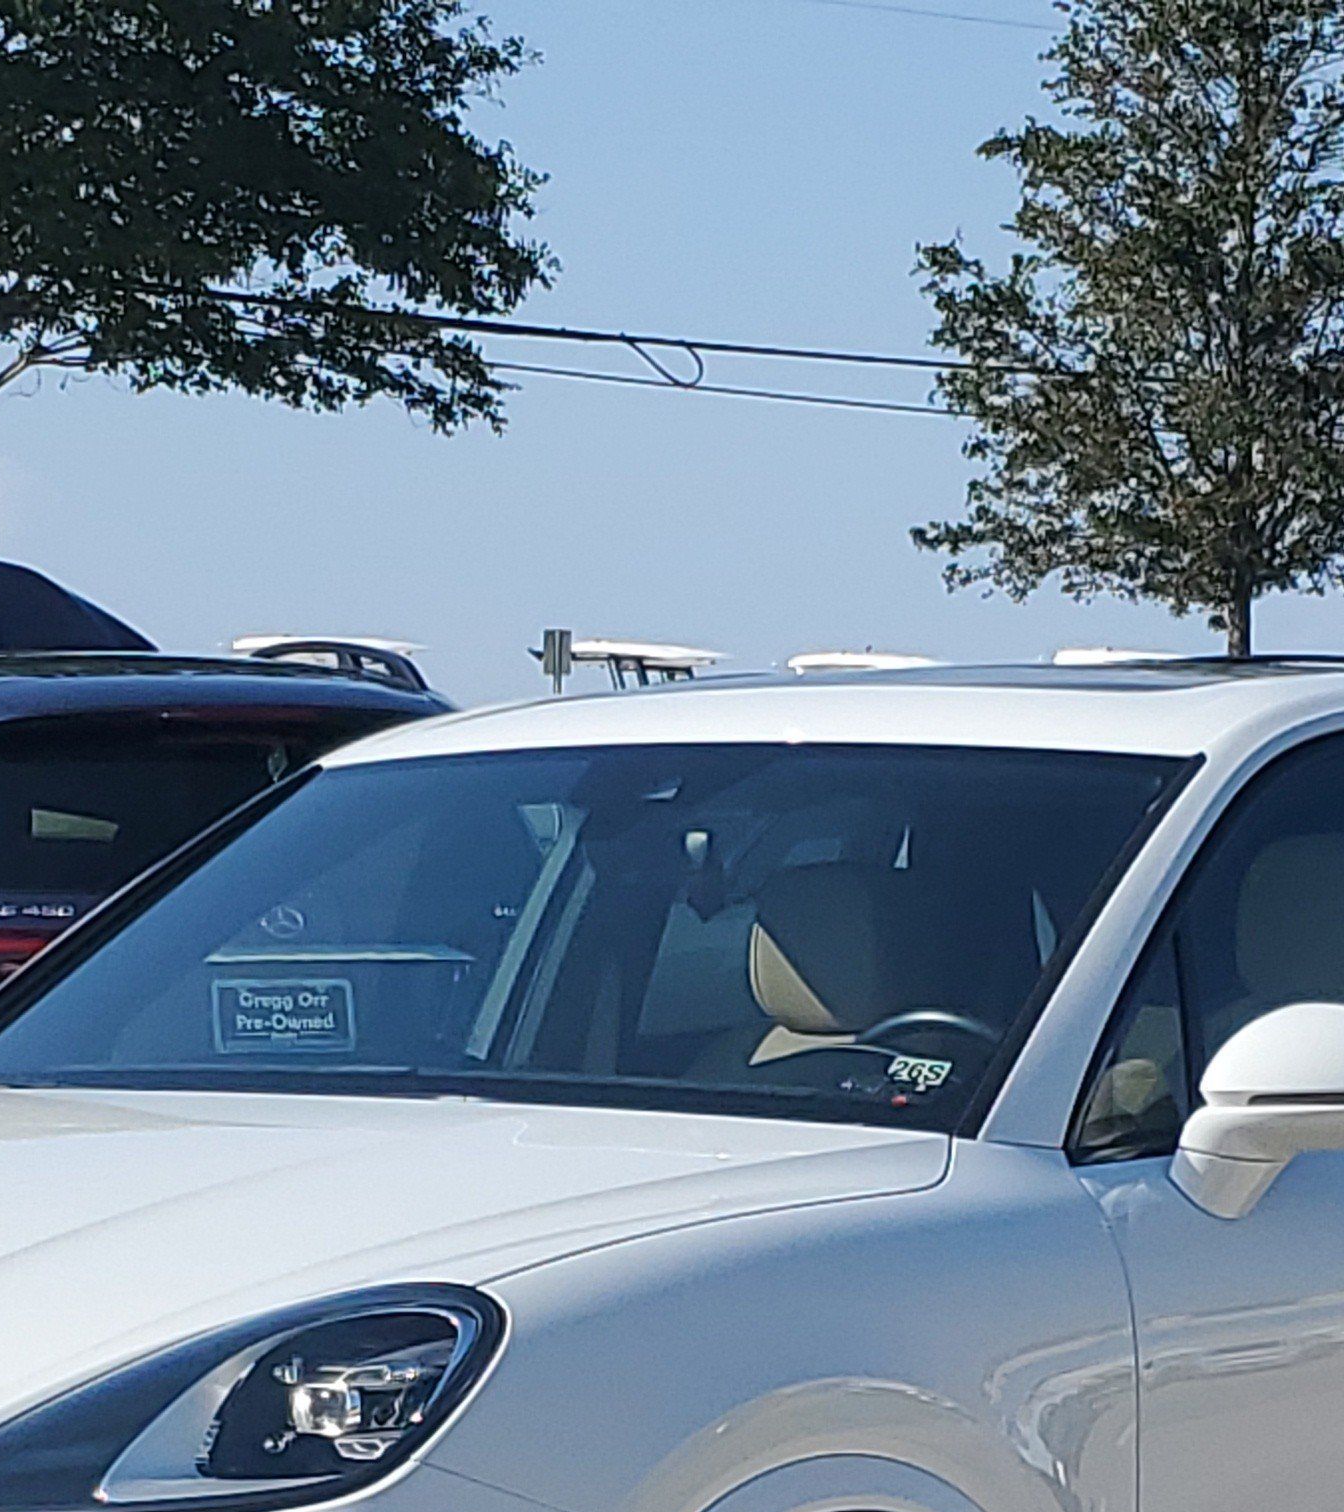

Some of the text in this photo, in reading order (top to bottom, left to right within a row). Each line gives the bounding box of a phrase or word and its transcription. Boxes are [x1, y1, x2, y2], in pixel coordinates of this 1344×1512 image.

[238, 991, 329, 1011] Gregg Orr
[236, 1012, 334, 1031] Pre-Owned
